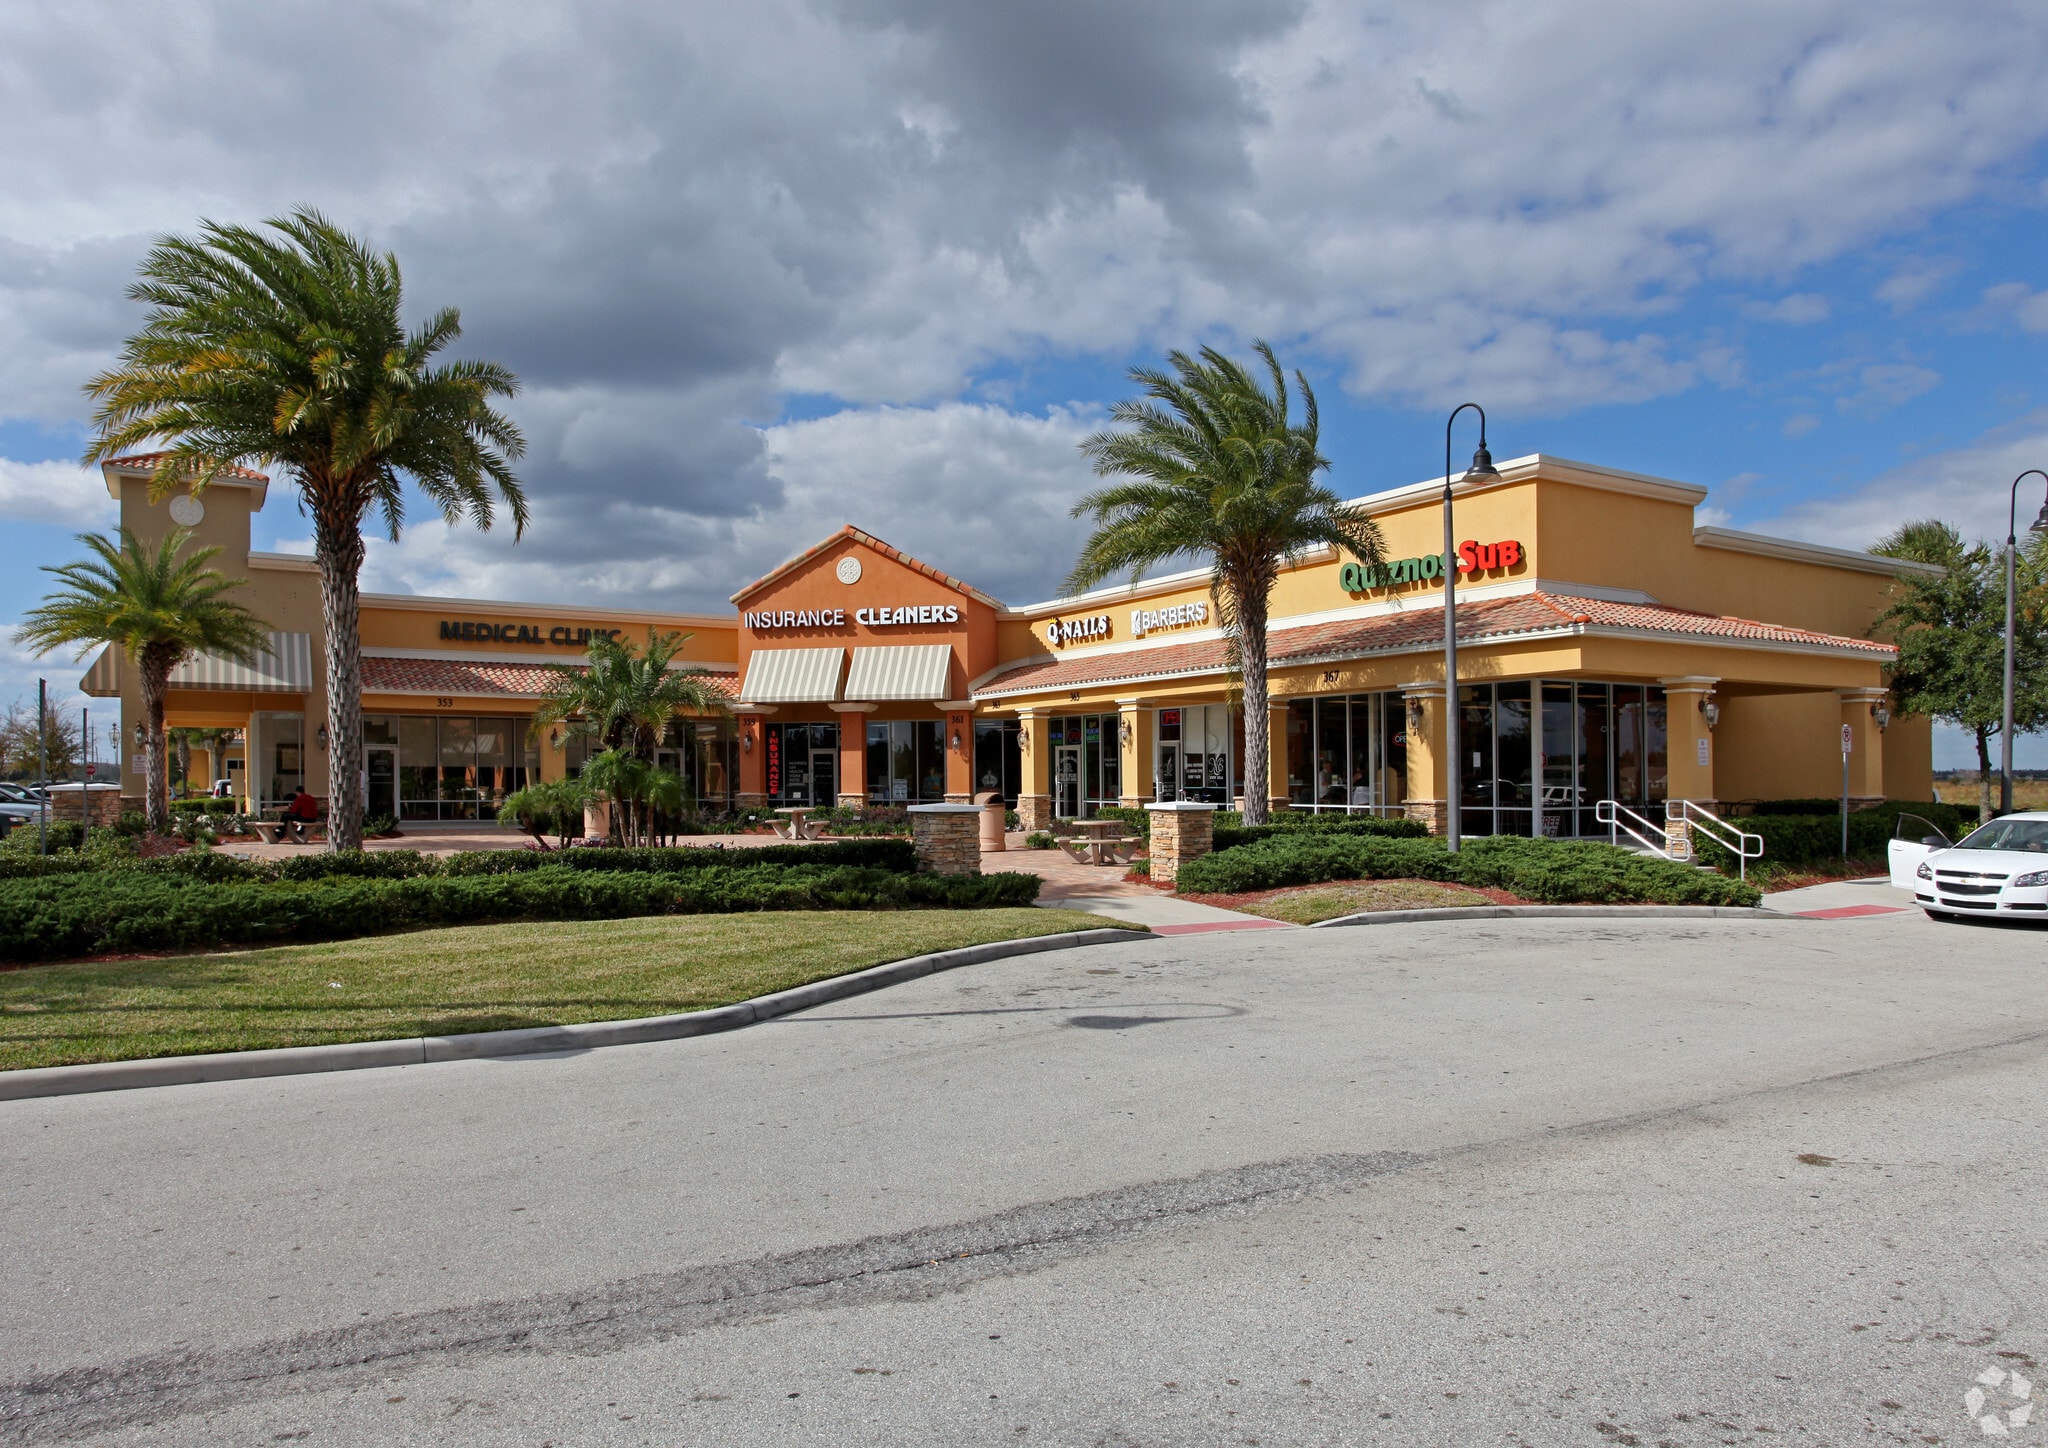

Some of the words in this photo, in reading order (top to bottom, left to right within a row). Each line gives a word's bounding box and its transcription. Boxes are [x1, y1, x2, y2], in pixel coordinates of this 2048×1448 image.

[1340, 554, 1447, 593] Quzno
[744, 608, 845, 629] INSURANCE
[855, 605, 959, 625] CLEANERS
[1142, 601, 1206, 630] BARBERS
[440, 620, 545, 644] MEDICAL
[1323, 670, 1340, 683] 367
[437, 698, 453, 707] 353
[743, 718, 756, 726] 359
[951, 715, 964, 724] 361
[1395, 735, 1407, 743] OPE
[769, 730, 779, 795] INSURANCE
